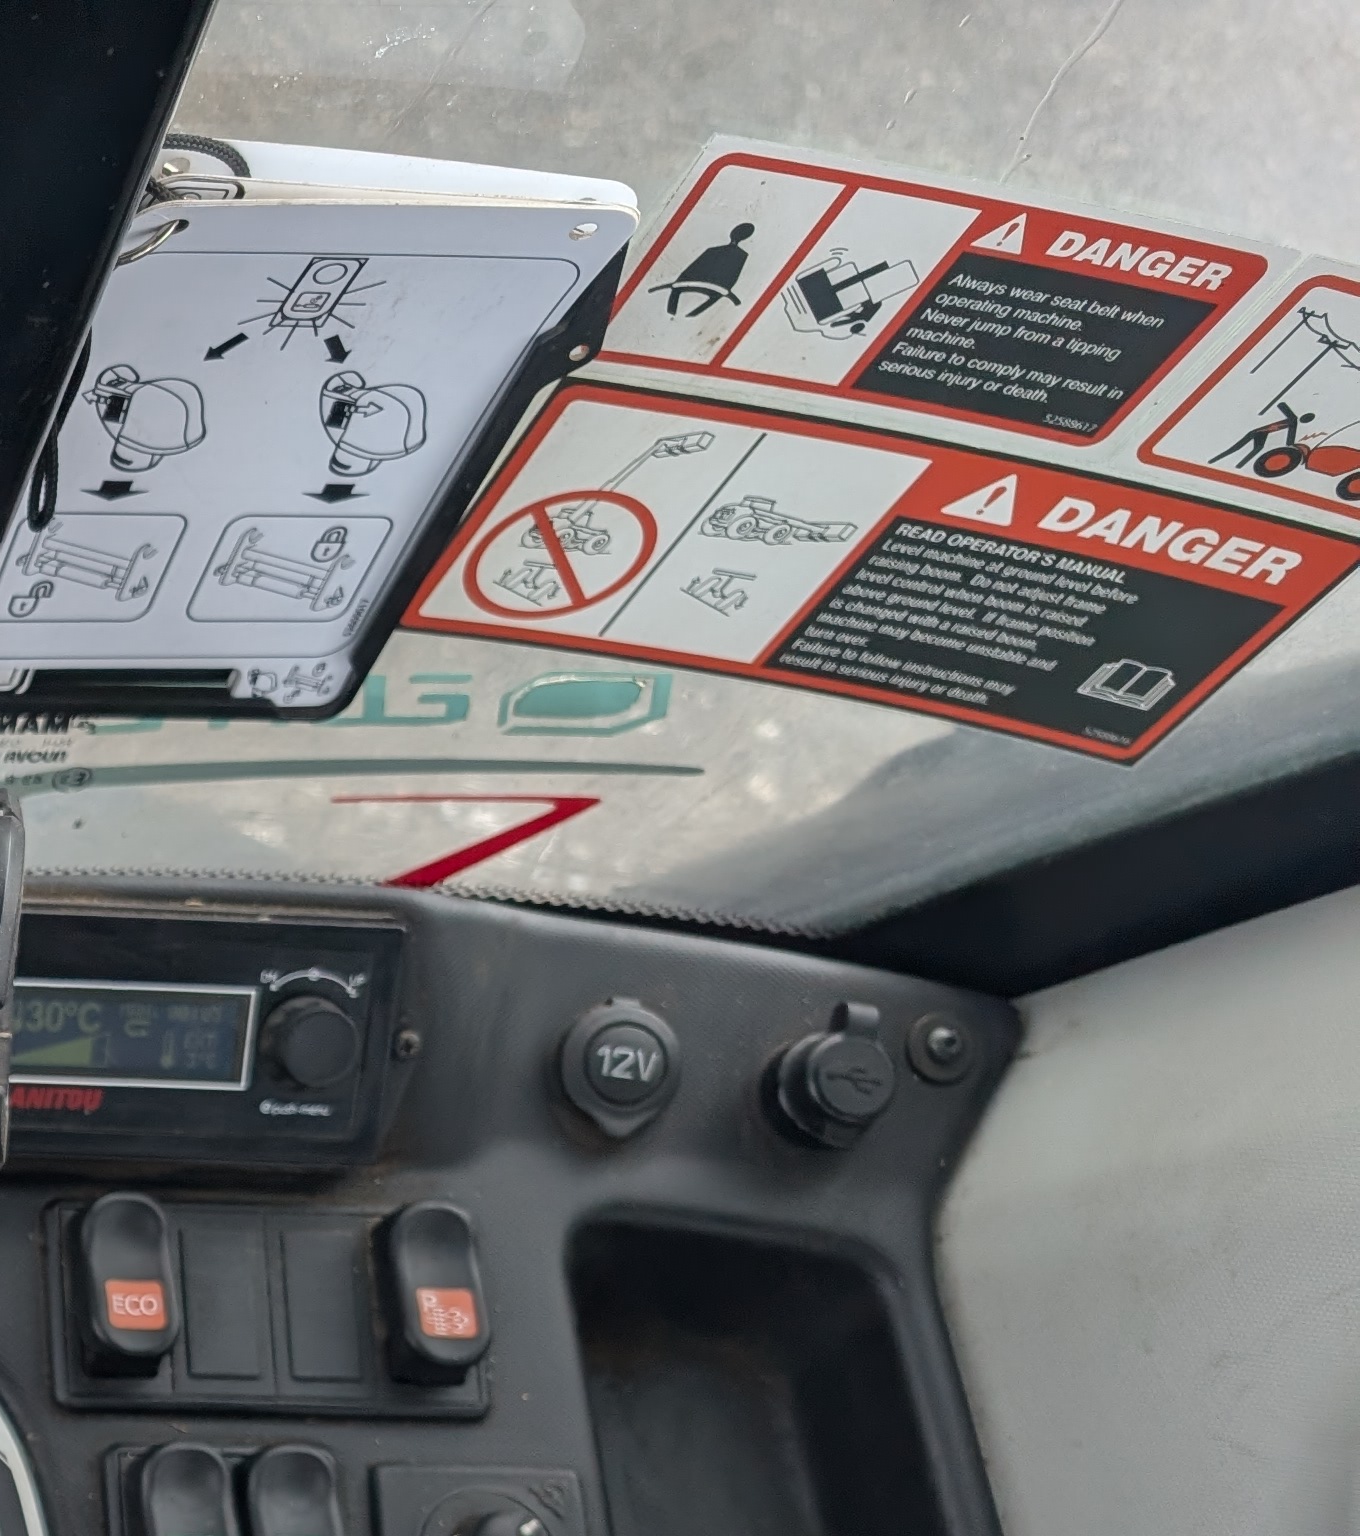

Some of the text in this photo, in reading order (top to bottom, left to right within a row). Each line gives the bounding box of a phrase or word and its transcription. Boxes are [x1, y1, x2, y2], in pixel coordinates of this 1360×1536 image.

[1046, 231, 1233, 291] DANGER
[935, 293, 1081, 330] operating machine.
[948, 273, 1164, 327] Always wear seat belt when
[906, 327, 974, 348] machine.
[920, 308, 1121, 361] Never jump from a tipping
[878, 361, 1047, 402] serious injury or death.
[892, 341, 1123, 399] Failure to comply may result in
[895, 523, 1125, 583] READ OPERATOR'S MANUAL
[1037, 496, 1302, 586] DANGER
[597, 1044, 661, 1082] 12V
[10, 1086, 104, 1113] ANITOU
[112, 1294, 158, 1317] ECO
